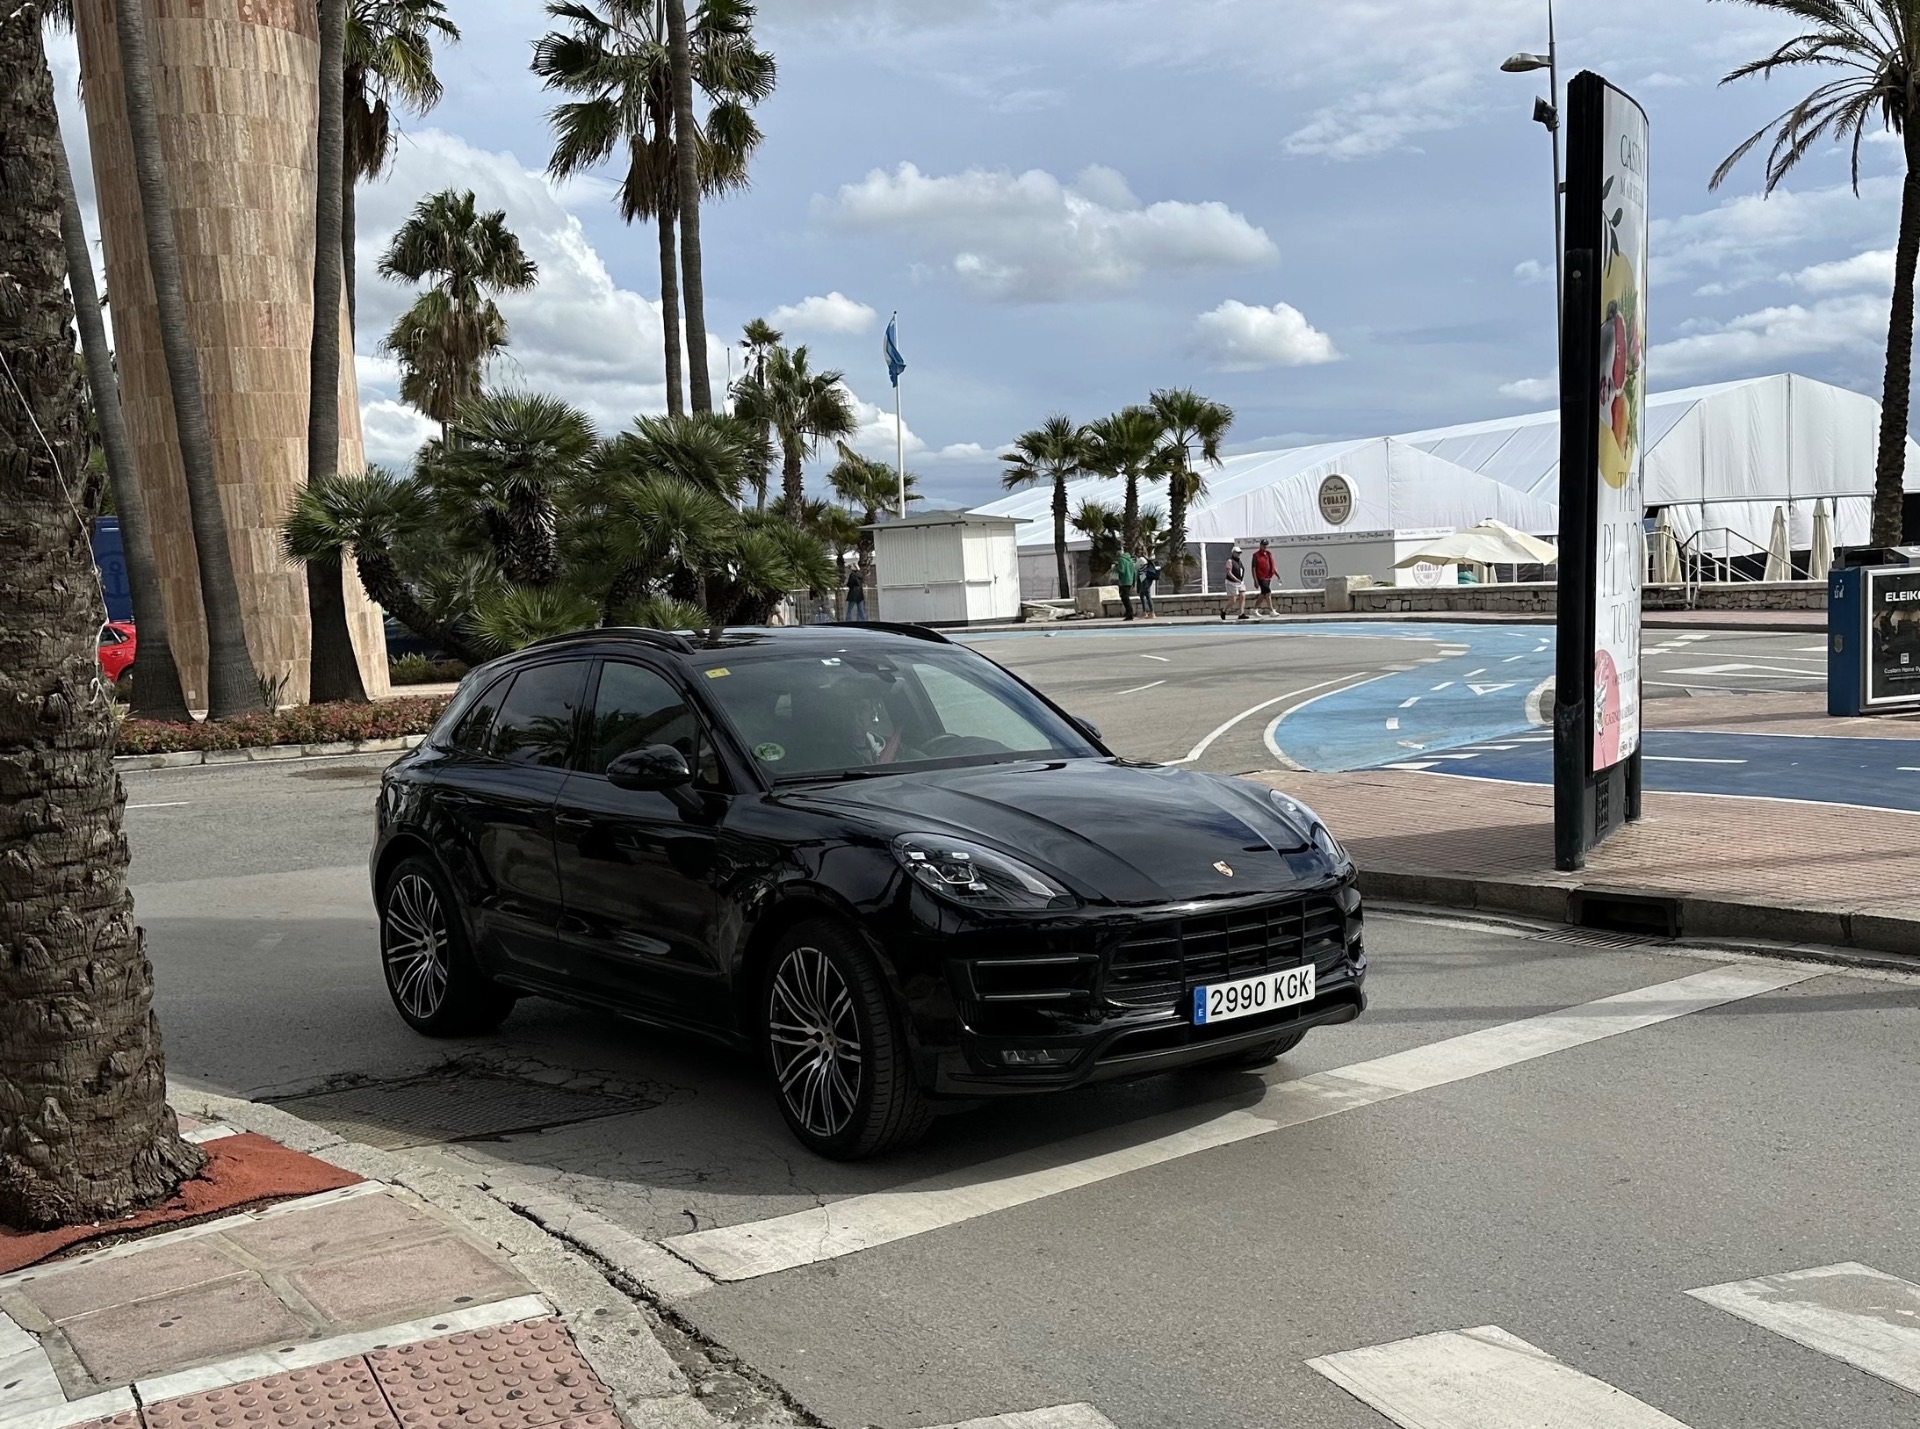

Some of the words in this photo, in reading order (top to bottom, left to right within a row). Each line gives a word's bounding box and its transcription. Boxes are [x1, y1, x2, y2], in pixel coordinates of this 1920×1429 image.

[1620, 134, 1644, 182] CASIN
[1618, 472, 1636, 512] THE
[1603, 522, 1641, 598] PLAC
[1885, 590, 1920, 602] ELEIK
[1611, 602, 1627, 645] TO
[1198, 1008, 1204, 1017] E
[1210, 980, 1266, 1017] 2990
[1274, 969, 1310, 1004] KGK
